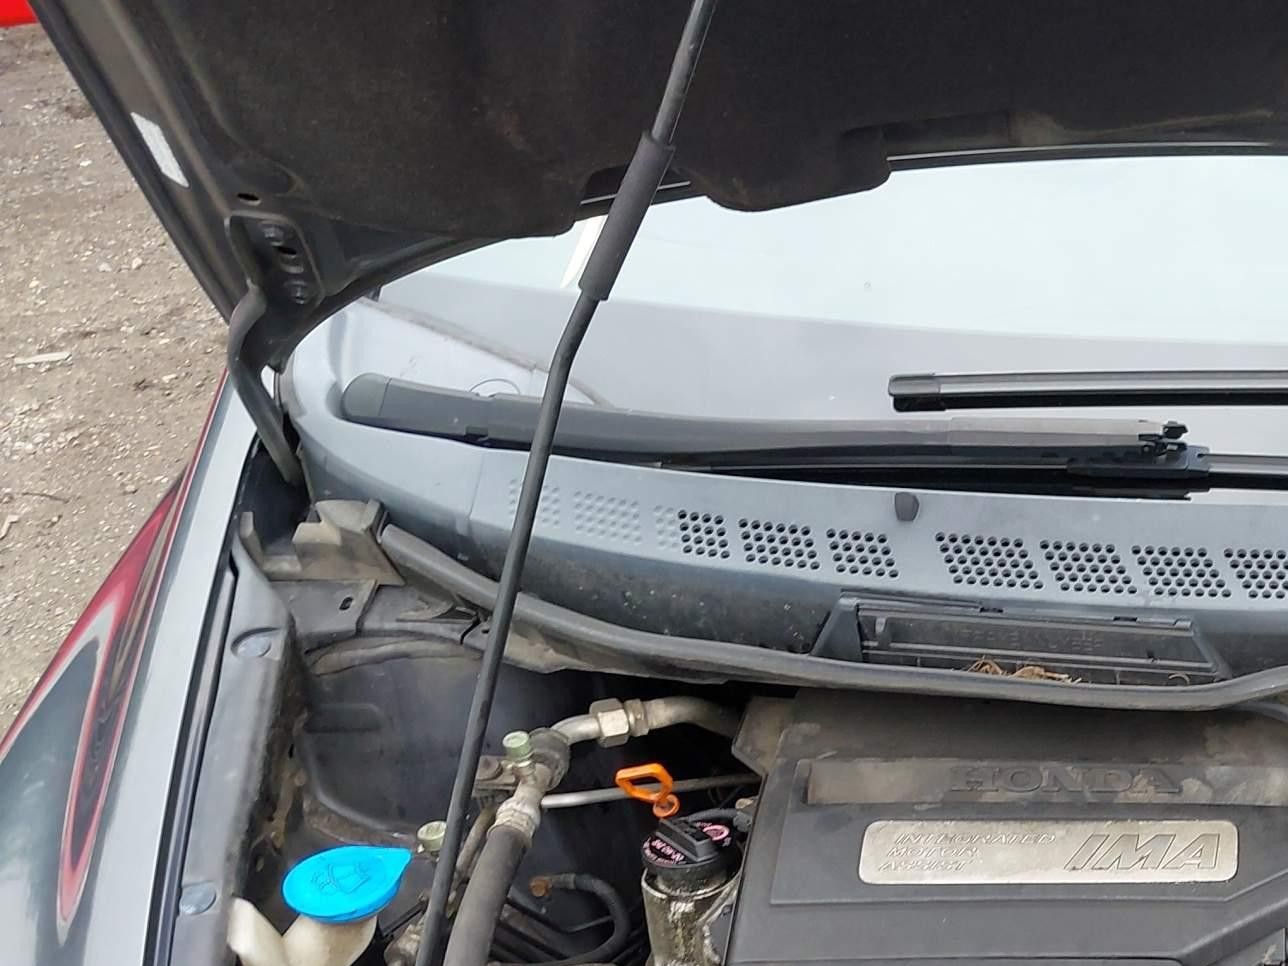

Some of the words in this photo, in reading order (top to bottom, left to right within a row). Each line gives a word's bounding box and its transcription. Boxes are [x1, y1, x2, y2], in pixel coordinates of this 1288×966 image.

[950, 766, 1183, 794] HONDA
[894, 831, 1056, 844] INTEGRATED
[886, 846, 979, 858] MOTOR
[1064, 833, 1221, 871] IMA
